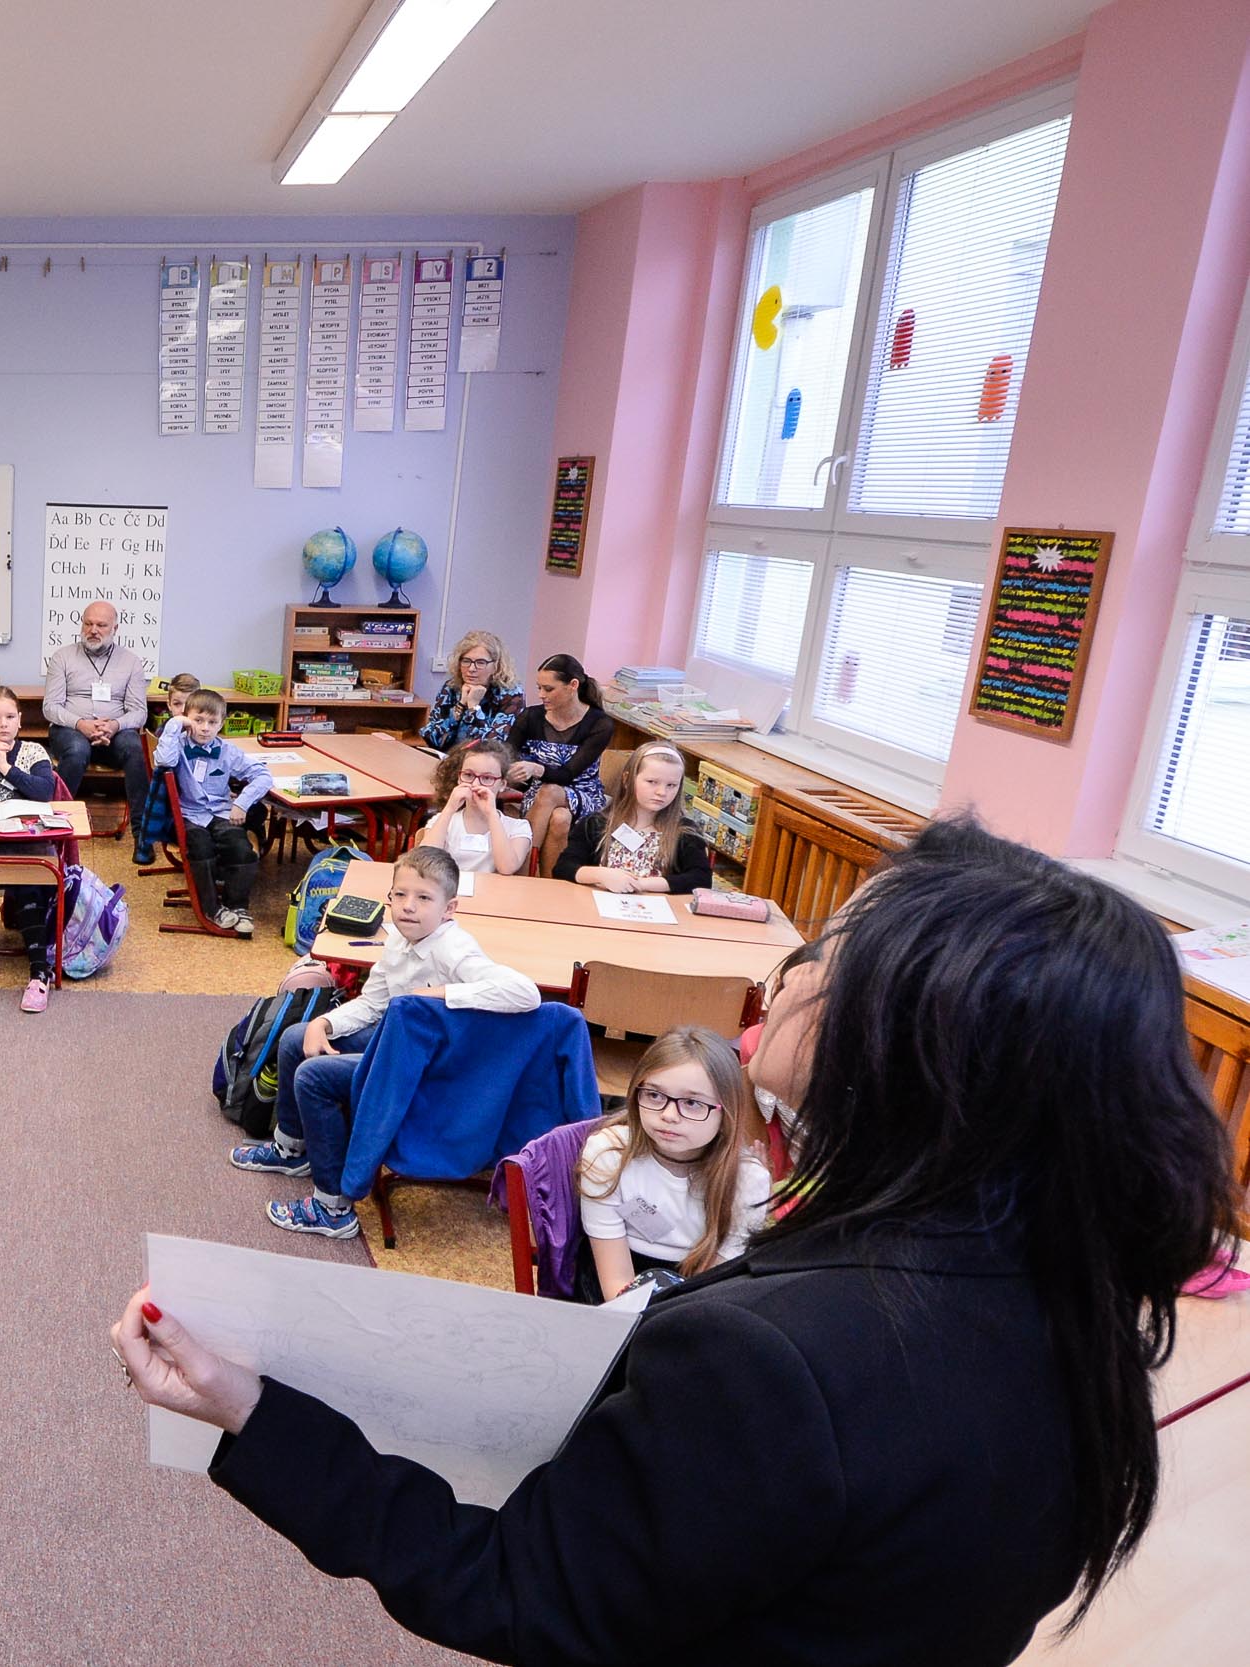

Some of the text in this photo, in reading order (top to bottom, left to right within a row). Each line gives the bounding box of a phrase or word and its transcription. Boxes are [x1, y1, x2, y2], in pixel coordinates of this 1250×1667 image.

[231, 269, 237, 279] L
[333, 267, 341, 278] P
[384, 265, 391, 276] S
[434, 265, 443, 275] V
[486, 262, 493, 273] Z
[281, 269, 292, 281] M
[51, 510, 165, 528] Aa Bb Cc Čč Dd
[74, 537, 90, 551] Ee
[100, 537, 114, 551] Ff
[121, 539, 140, 555] Gg
[145, 539, 164, 553] Hh
[101, 563, 110, 575] Ii
[124, 563, 135, 580] Jj
[143, 564, 162, 577] Kk
[50, 585, 161, 601] Ll Mm Nn Ňň Oo
[48, 610, 64, 626] Pp
[119, 607, 136, 625] Řř
[143, 613, 158, 625] Ss
[48, 632, 62, 646] Šš
[118, 636, 135, 649] Uu
[140, 636, 158, 649] Vv
